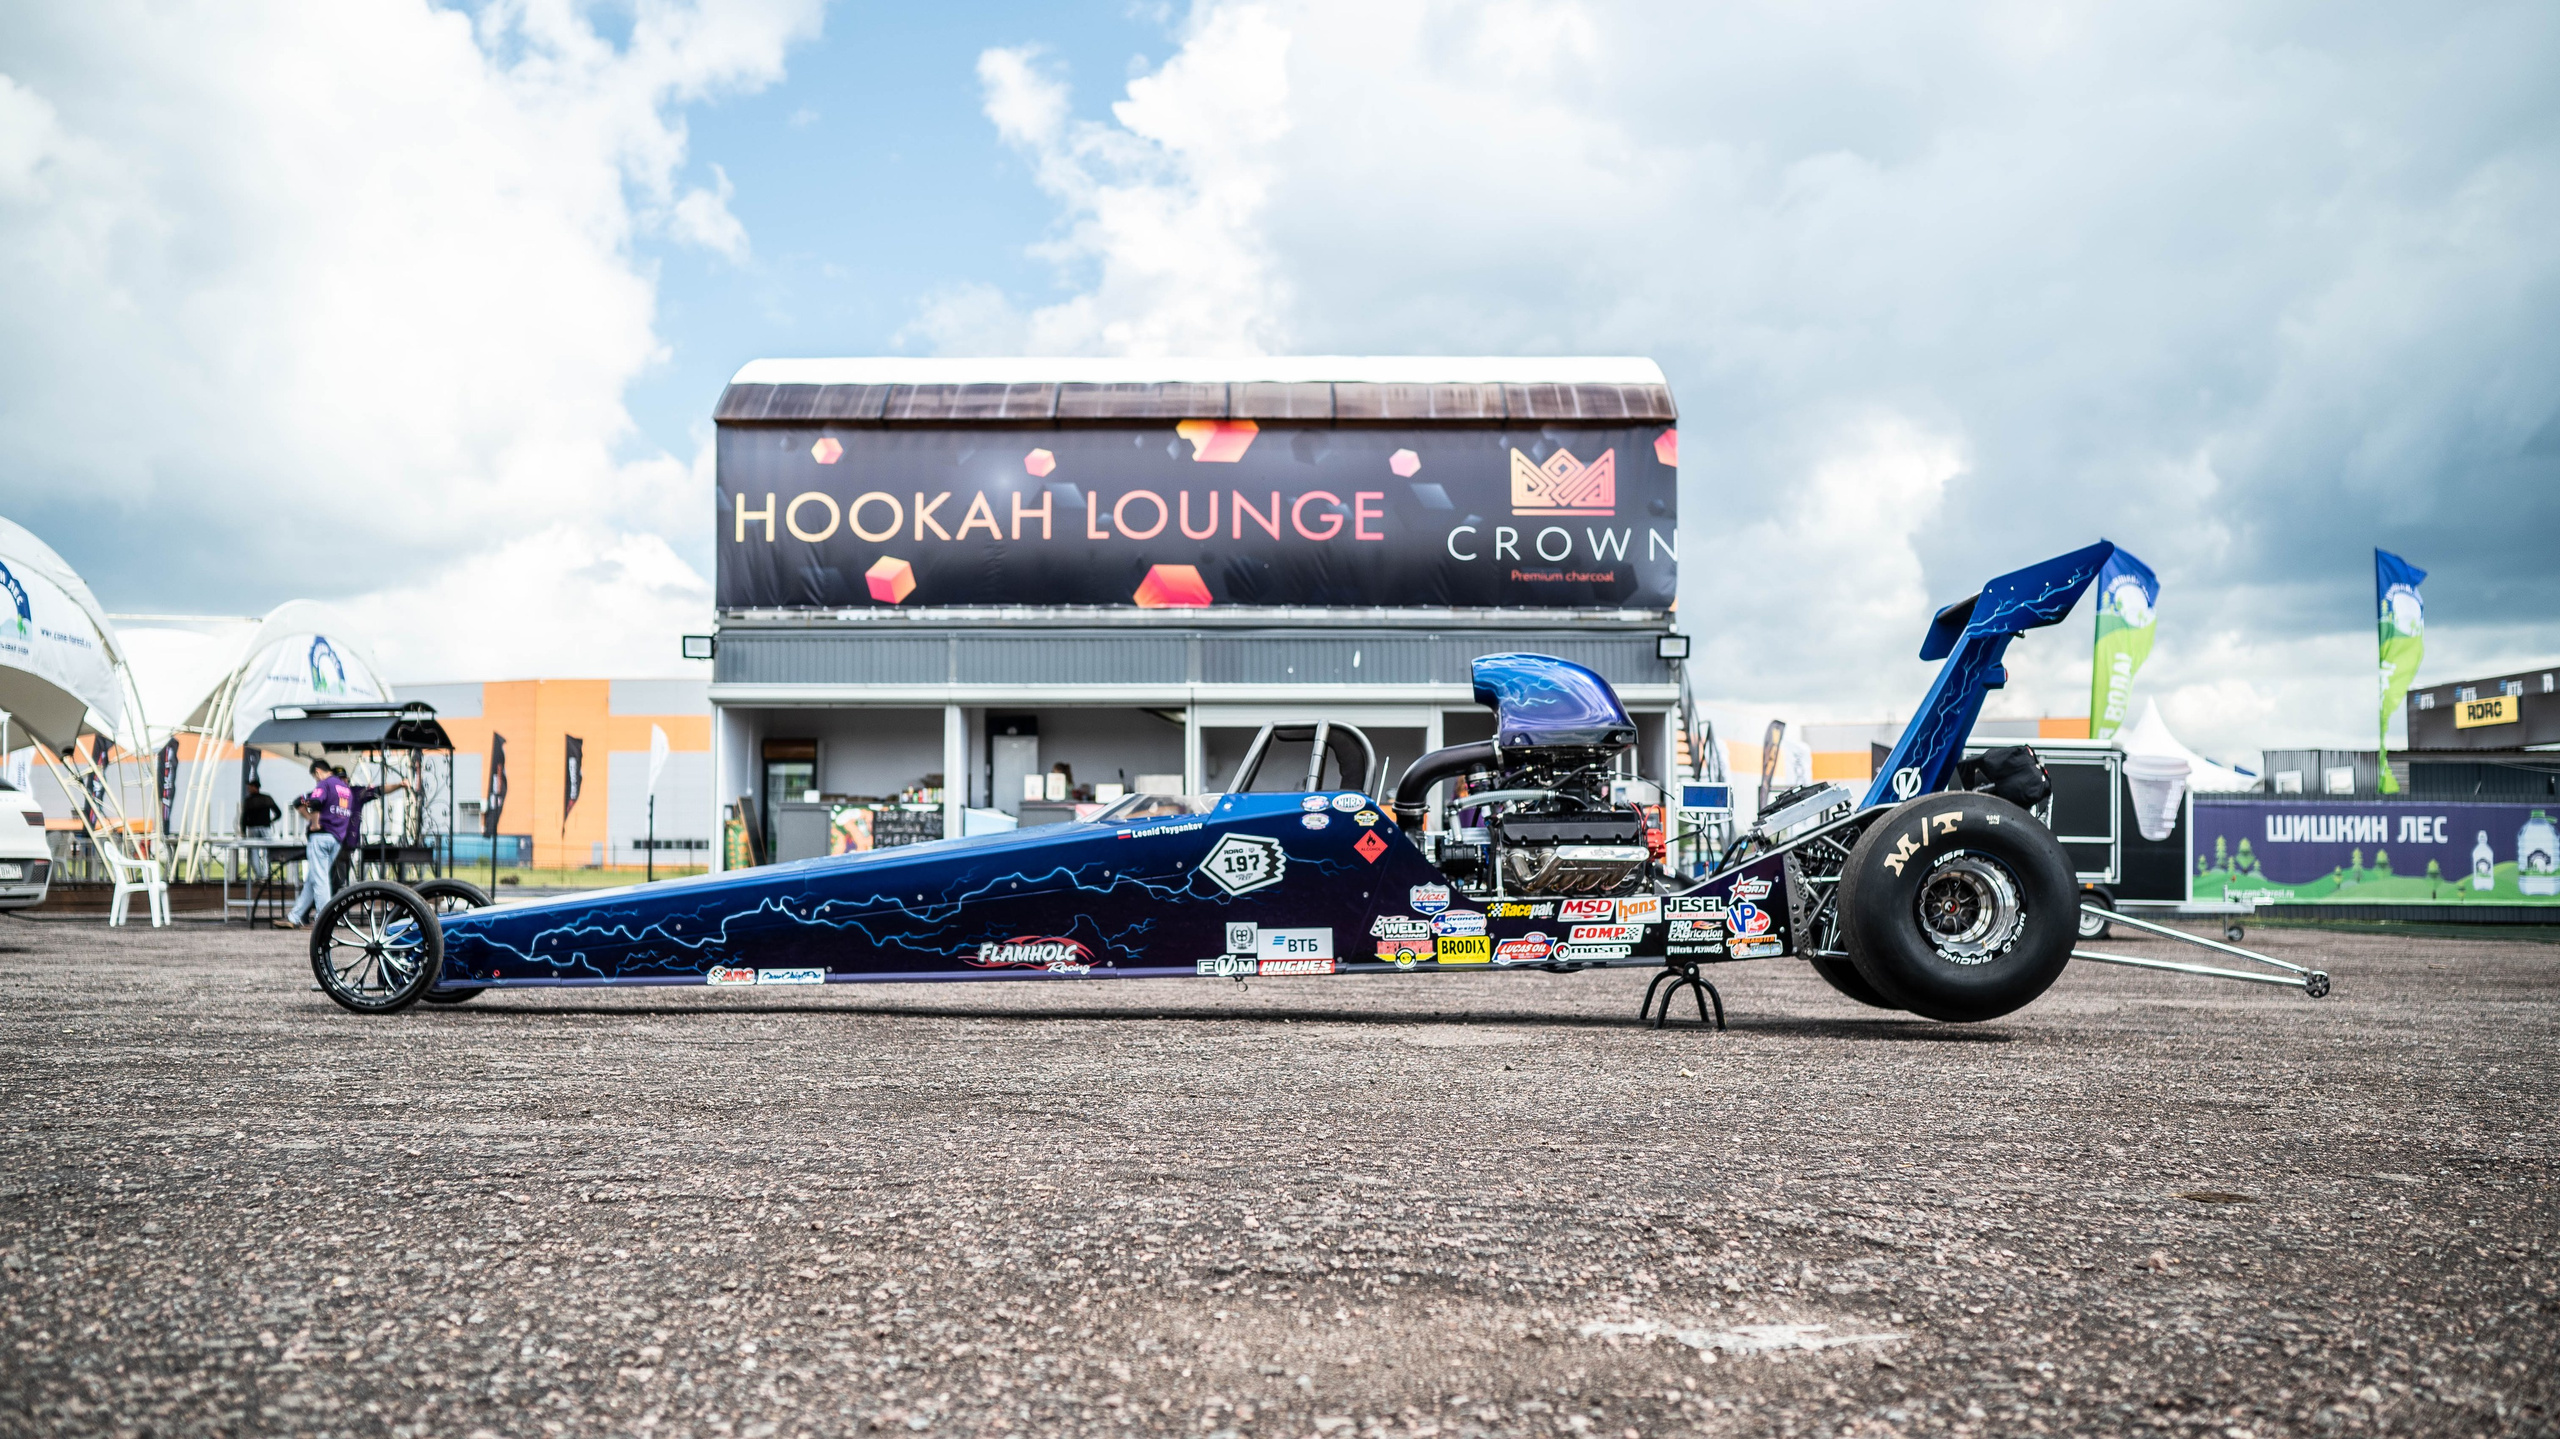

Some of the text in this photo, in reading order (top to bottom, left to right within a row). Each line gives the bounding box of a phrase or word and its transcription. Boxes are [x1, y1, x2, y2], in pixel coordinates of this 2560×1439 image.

[735, 489, 1385, 543] HOOKAH LOUNGE
[1447, 525, 1679, 562] CROWN
[1511, 569, 1615, 582] Premium charcoal
[2468, 701, 2503, 721] RDRC
[1132, 822, 1203, 838] Leonid Tsygankov
[2266, 814, 2449, 844] ШИШКИН ЛЕС
[1224, 854, 1260, 873] 197
[1933, 849, 1965, 868] USA
[1737, 885, 1767, 893] PDRA
[1416, 893, 1446, 901] LUCAS
[1501, 902, 1554, 919] Racepak
[1563, 900, 1613, 913] MSD
[1618, 899, 1657, 922] hans
[1666, 898, 1724, 912] JESEL
[1670, 920, 1692, 930] PRO
[1729, 904, 1757, 933] VP
[1385, 923, 1427, 934] WELD
[1573, 927, 1626, 939] COMP
[1288, 938, 1318, 952] ВТБ
[1936, 912, 2027, 965] WELD RACING
[979, 942, 1078, 962] FLAMHOLC
[1441, 940, 1486, 955] BRODIX
[1501, 943, 1547, 953] LUCAS OIL
[1047, 961, 1090, 975] Racing
[1260, 960, 1332, 971] HUGHES
[722, 969, 754, 981] ARC
